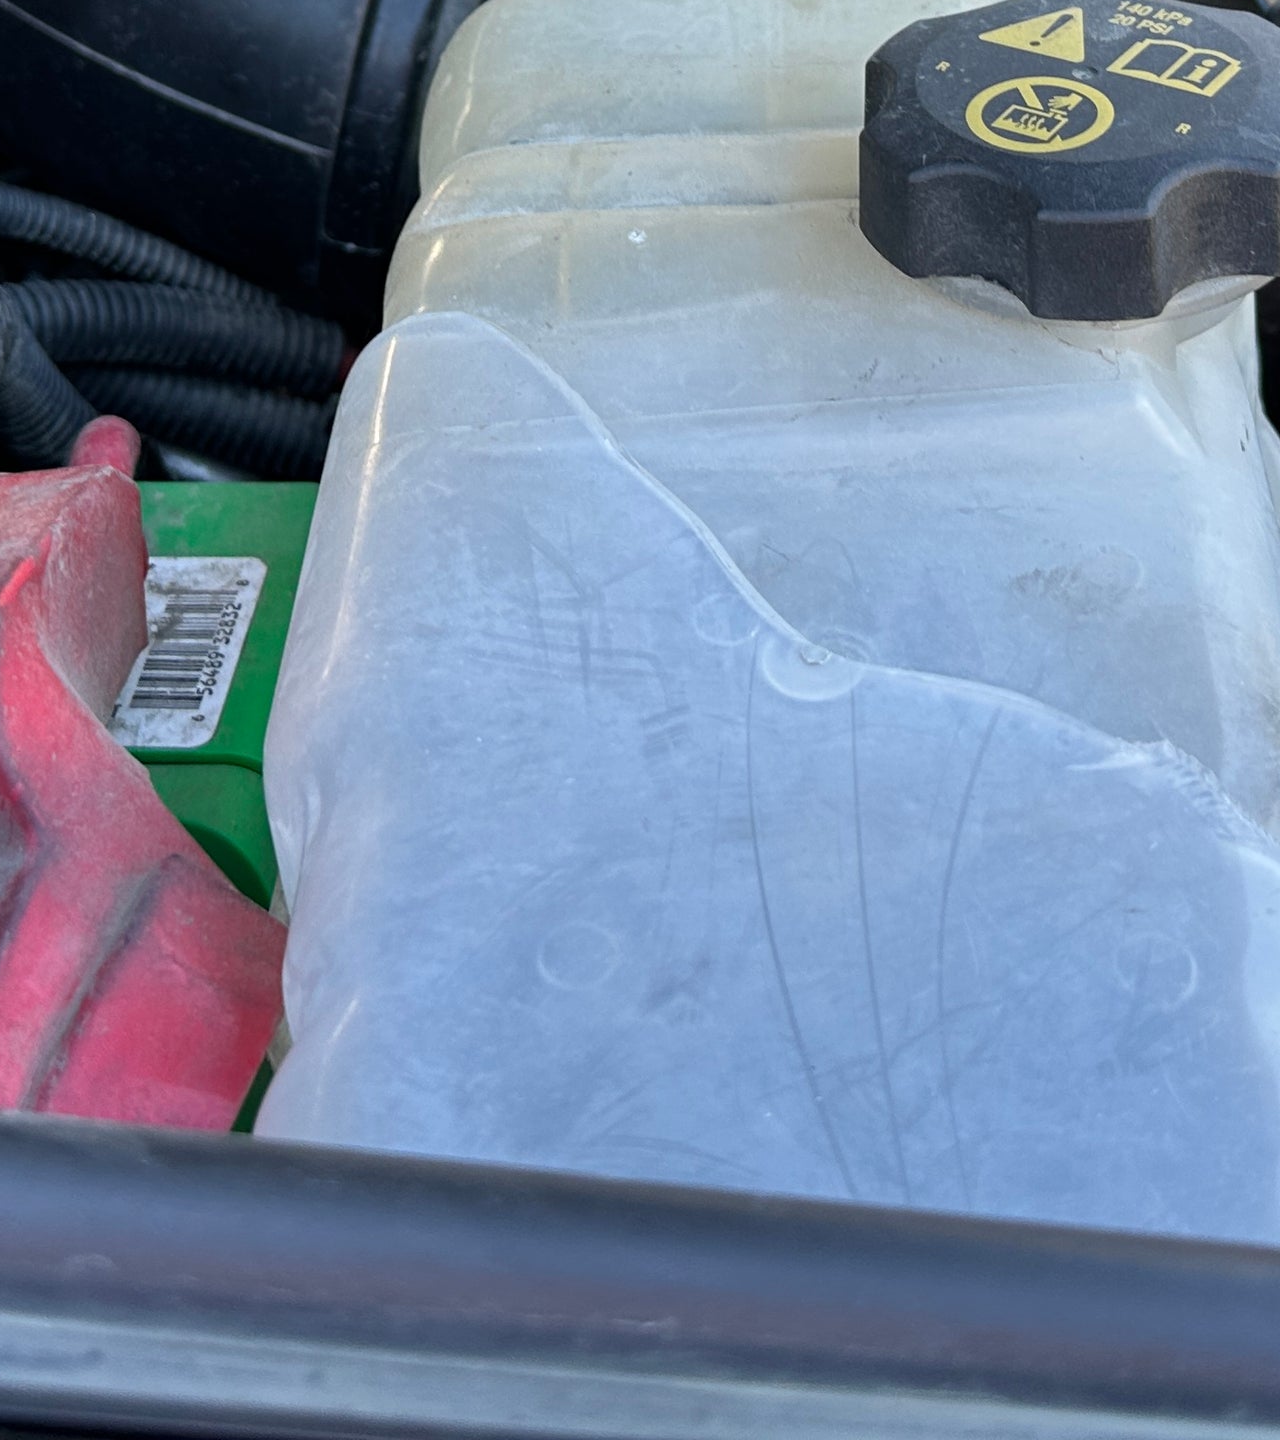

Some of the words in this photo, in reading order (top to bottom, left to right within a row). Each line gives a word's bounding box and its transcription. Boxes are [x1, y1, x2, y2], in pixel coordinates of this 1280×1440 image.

[1108, 13, 1136, 27] 20
[1136, 19, 1175, 35] PSI
[1117, 0, 1153, 18] 140
[1153, 8, 1194, 27] kPa
[196, 651, 226, 696] 56489
[212, 603, 243, 647] 32832
